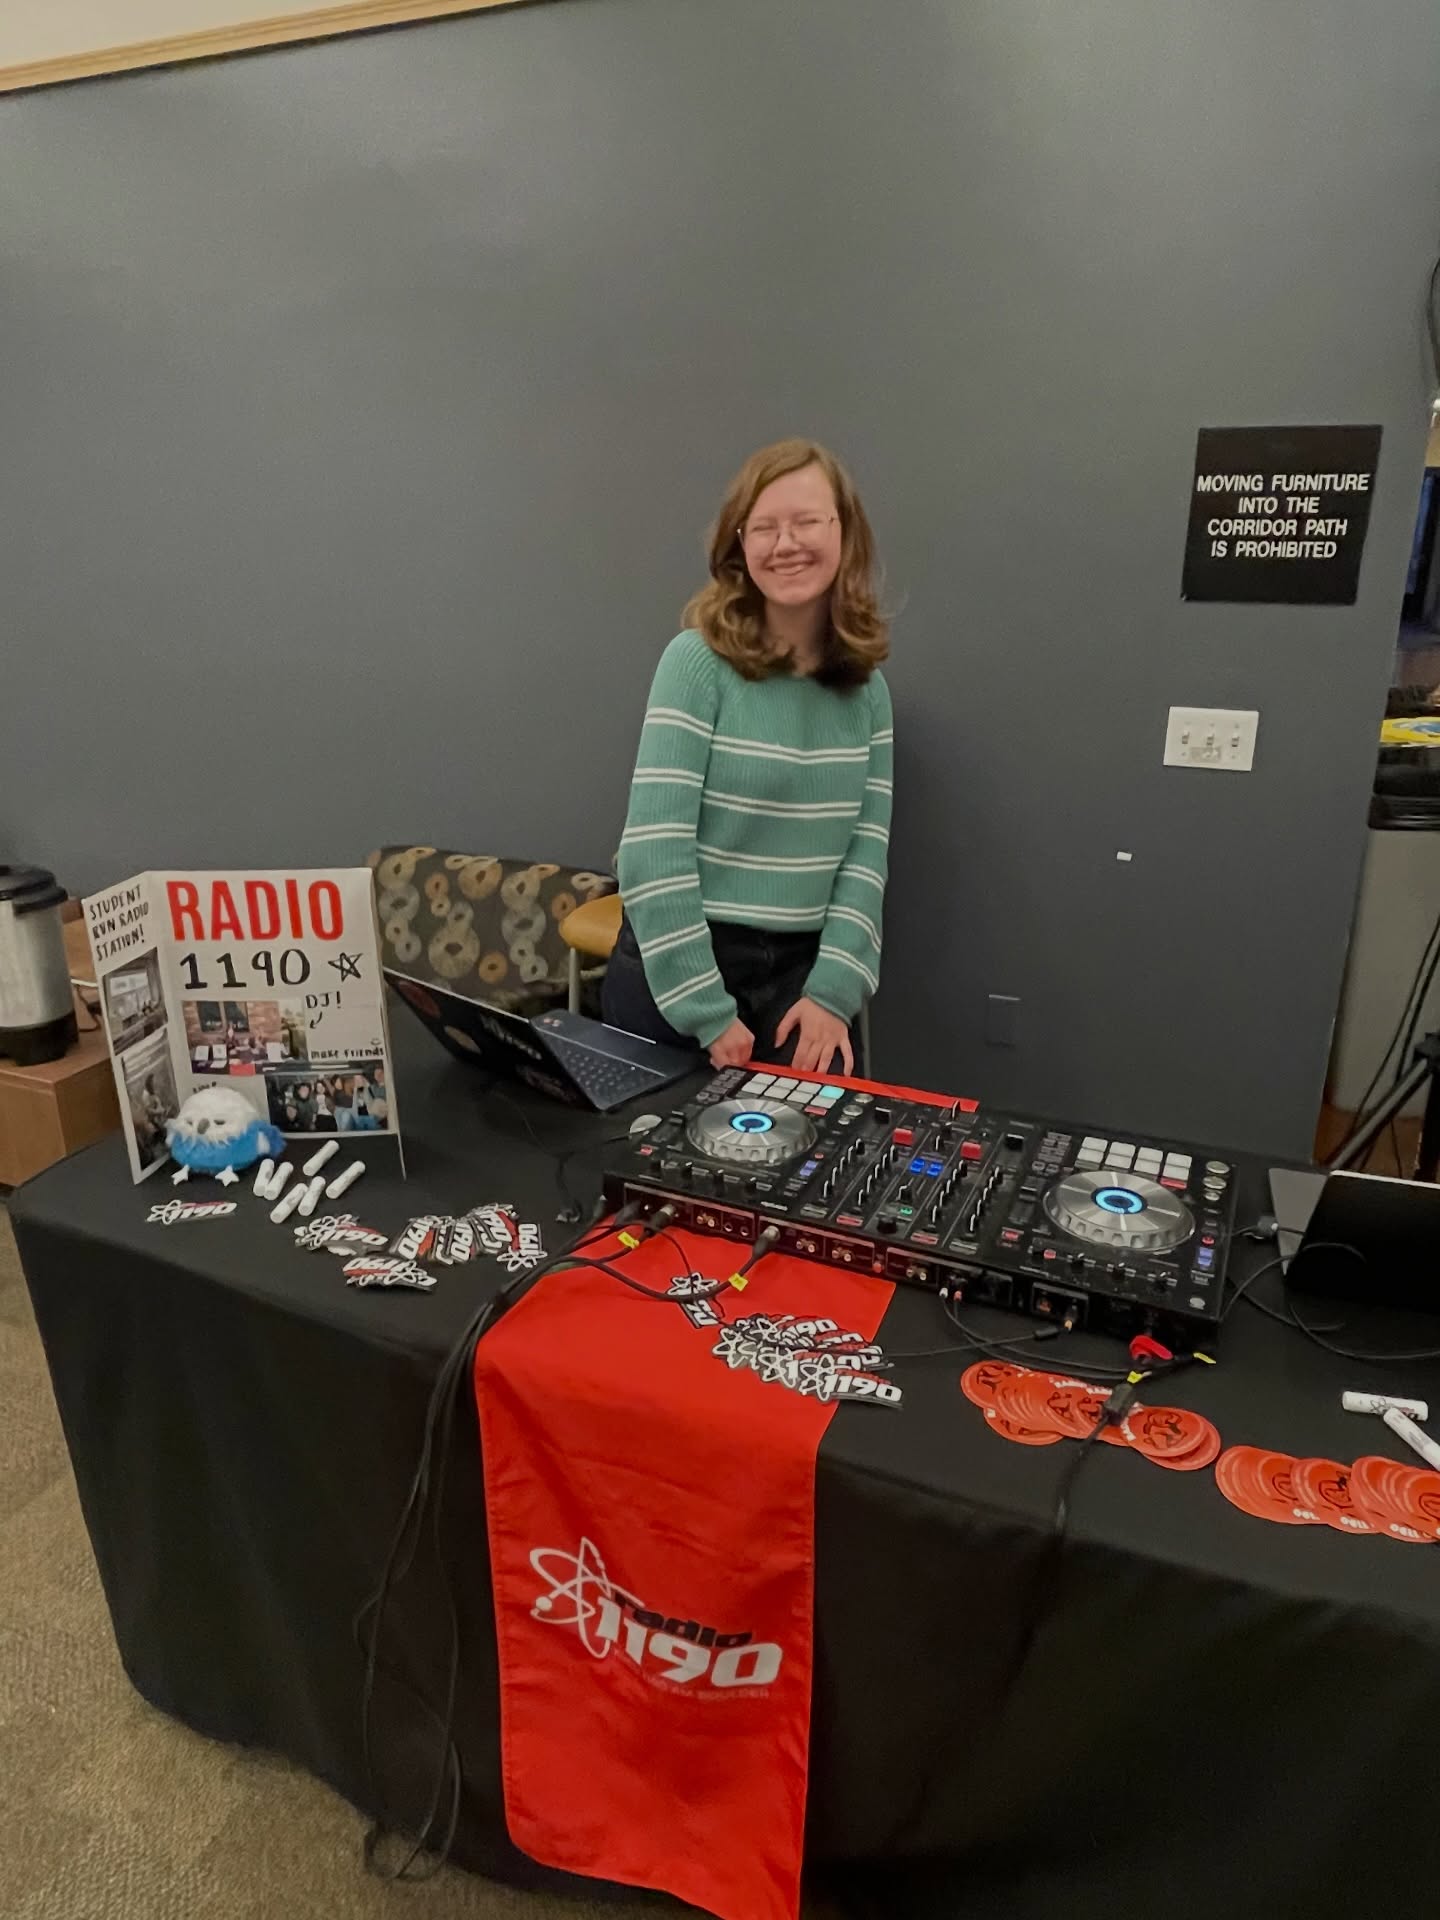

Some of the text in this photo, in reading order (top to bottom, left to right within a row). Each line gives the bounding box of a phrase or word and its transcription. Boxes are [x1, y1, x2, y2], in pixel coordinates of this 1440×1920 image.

[1197, 473, 1370, 492] MOVING FURNITURE
[1237, 497, 1320, 514] INTO THE
[1207, 519, 1347, 536] CORRIDOR PATH
[1210, 541, 1337, 558] IS PROHIBITED
[90, 884, 141, 920] STUDENT
[166, 879, 344, 942] RADIO
[96, 923, 145, 962] STATION!
[179, 948, 311, 990] 1190
[305, 990, 342, 1010] DJ!
[311, 1047, 384, 1060] make friends
[822, 1373, 902, 1402] 1190
[614, 1591, 753, 1648] radio
[596, 1596, 784, 1688] 1190
